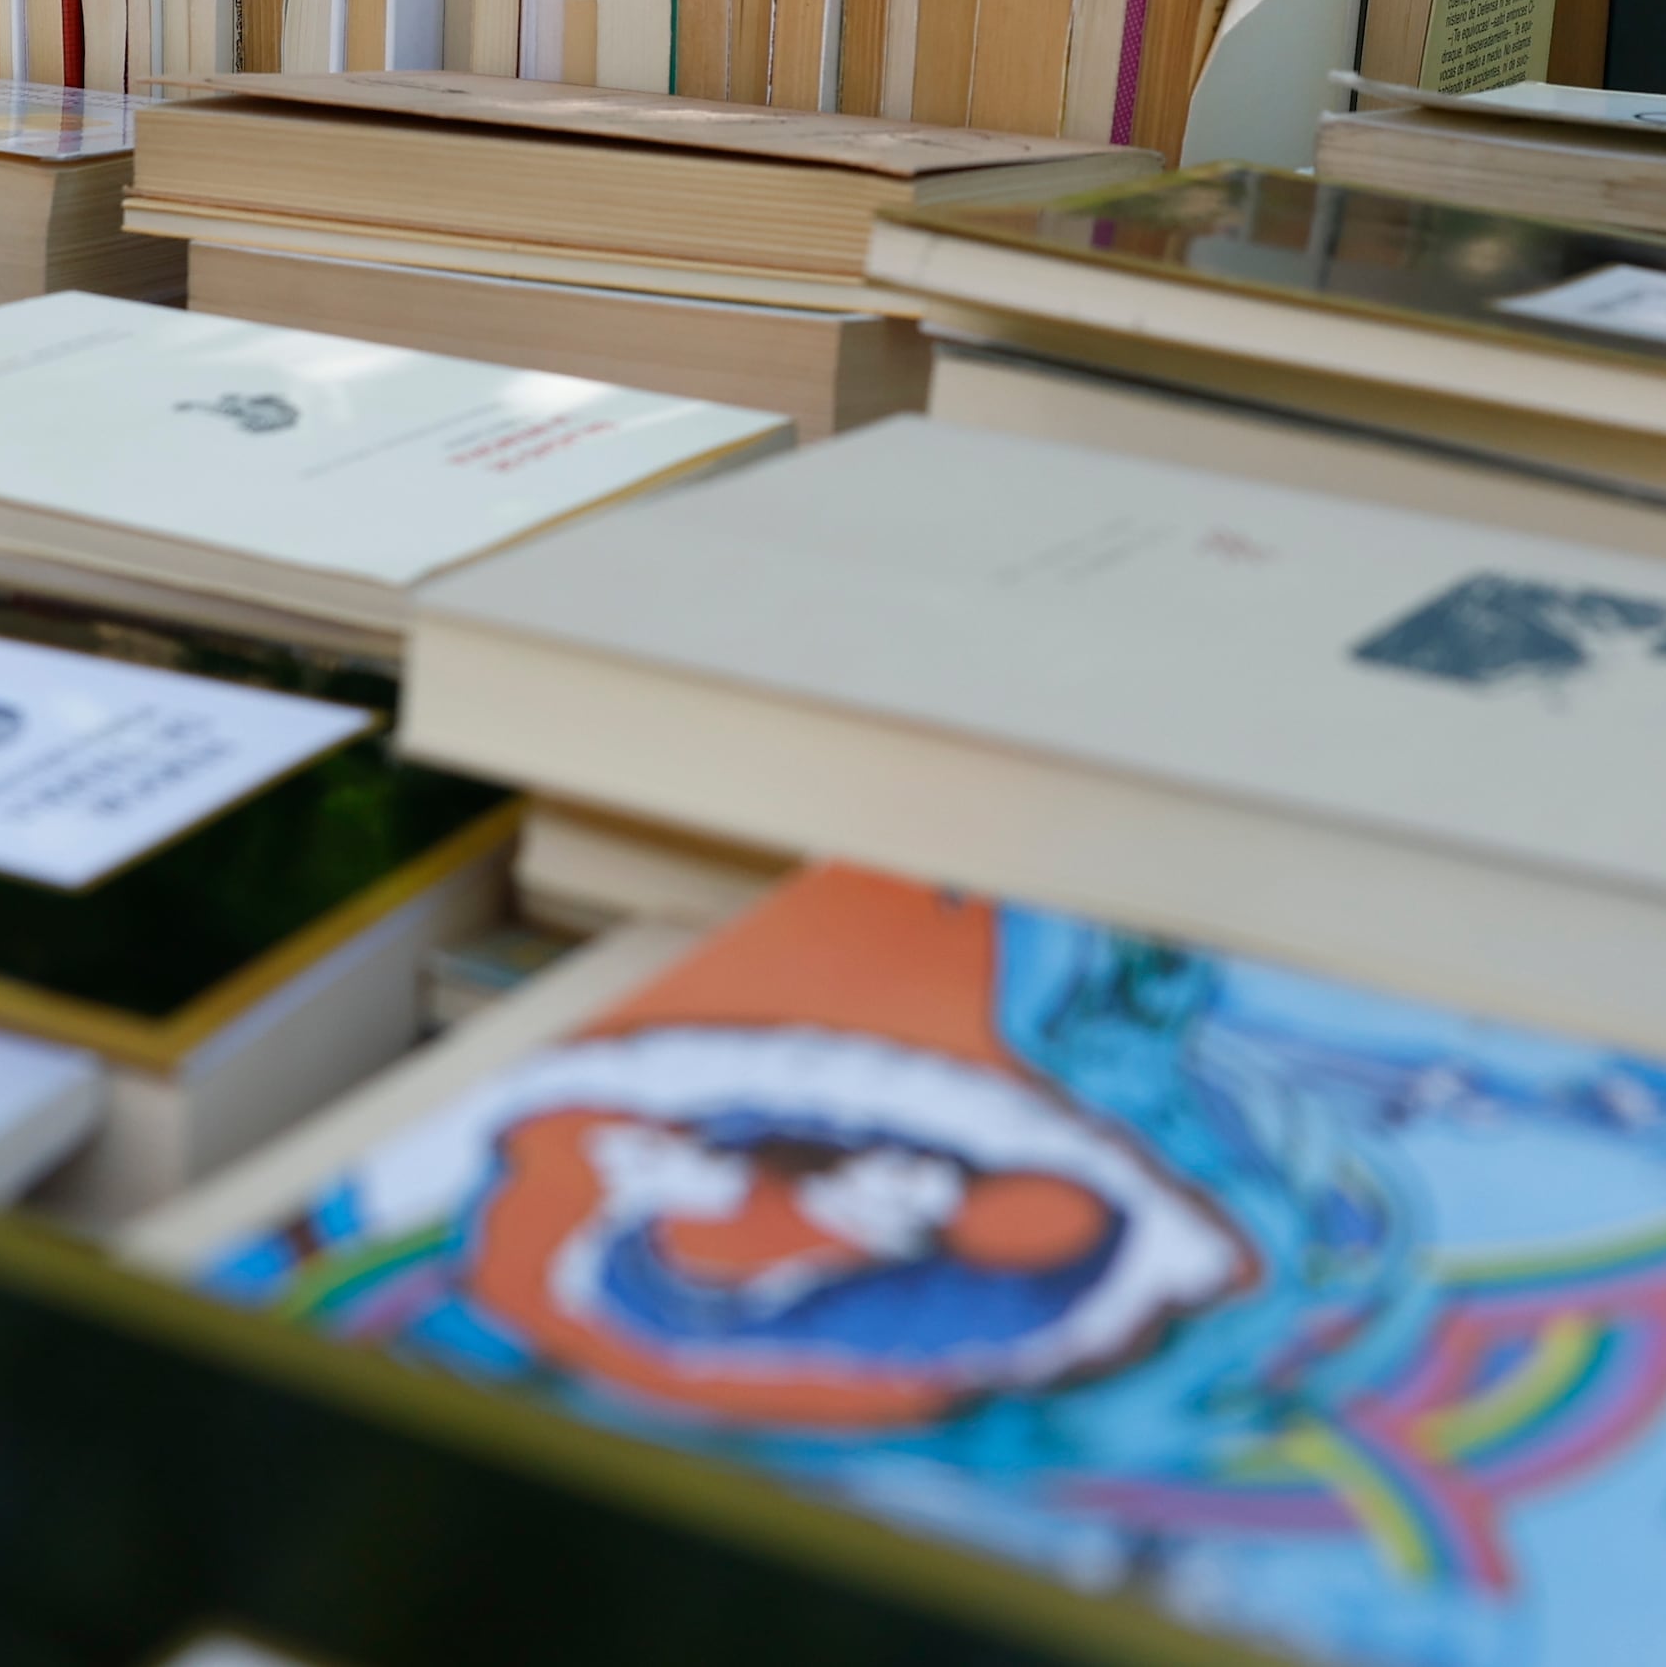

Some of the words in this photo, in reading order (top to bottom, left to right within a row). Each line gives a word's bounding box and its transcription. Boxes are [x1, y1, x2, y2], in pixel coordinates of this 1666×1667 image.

[1446, 10, 1467, 27] nisterio
[1469, 7, 1475, 20] de
[1477, 0, 1498, 17] Defensa
[1506, 5, 1528, 22] entonces
[1515, 22, 1521, 35] Te
[1440, 67, 1456, 82] vocas
[1457, 63, 1464, 75] de
[1465, 55, 1481, 71] medio
[1503, 44, 1511, 55] No
[1512, 36, 1531, 53] estamos
[1438, 80, 1463, 94] hablando
[1464, 77, 1471, 89] de
[1502, 62, 1507, 74] ni
[1509, 59, 1515, 71] de
